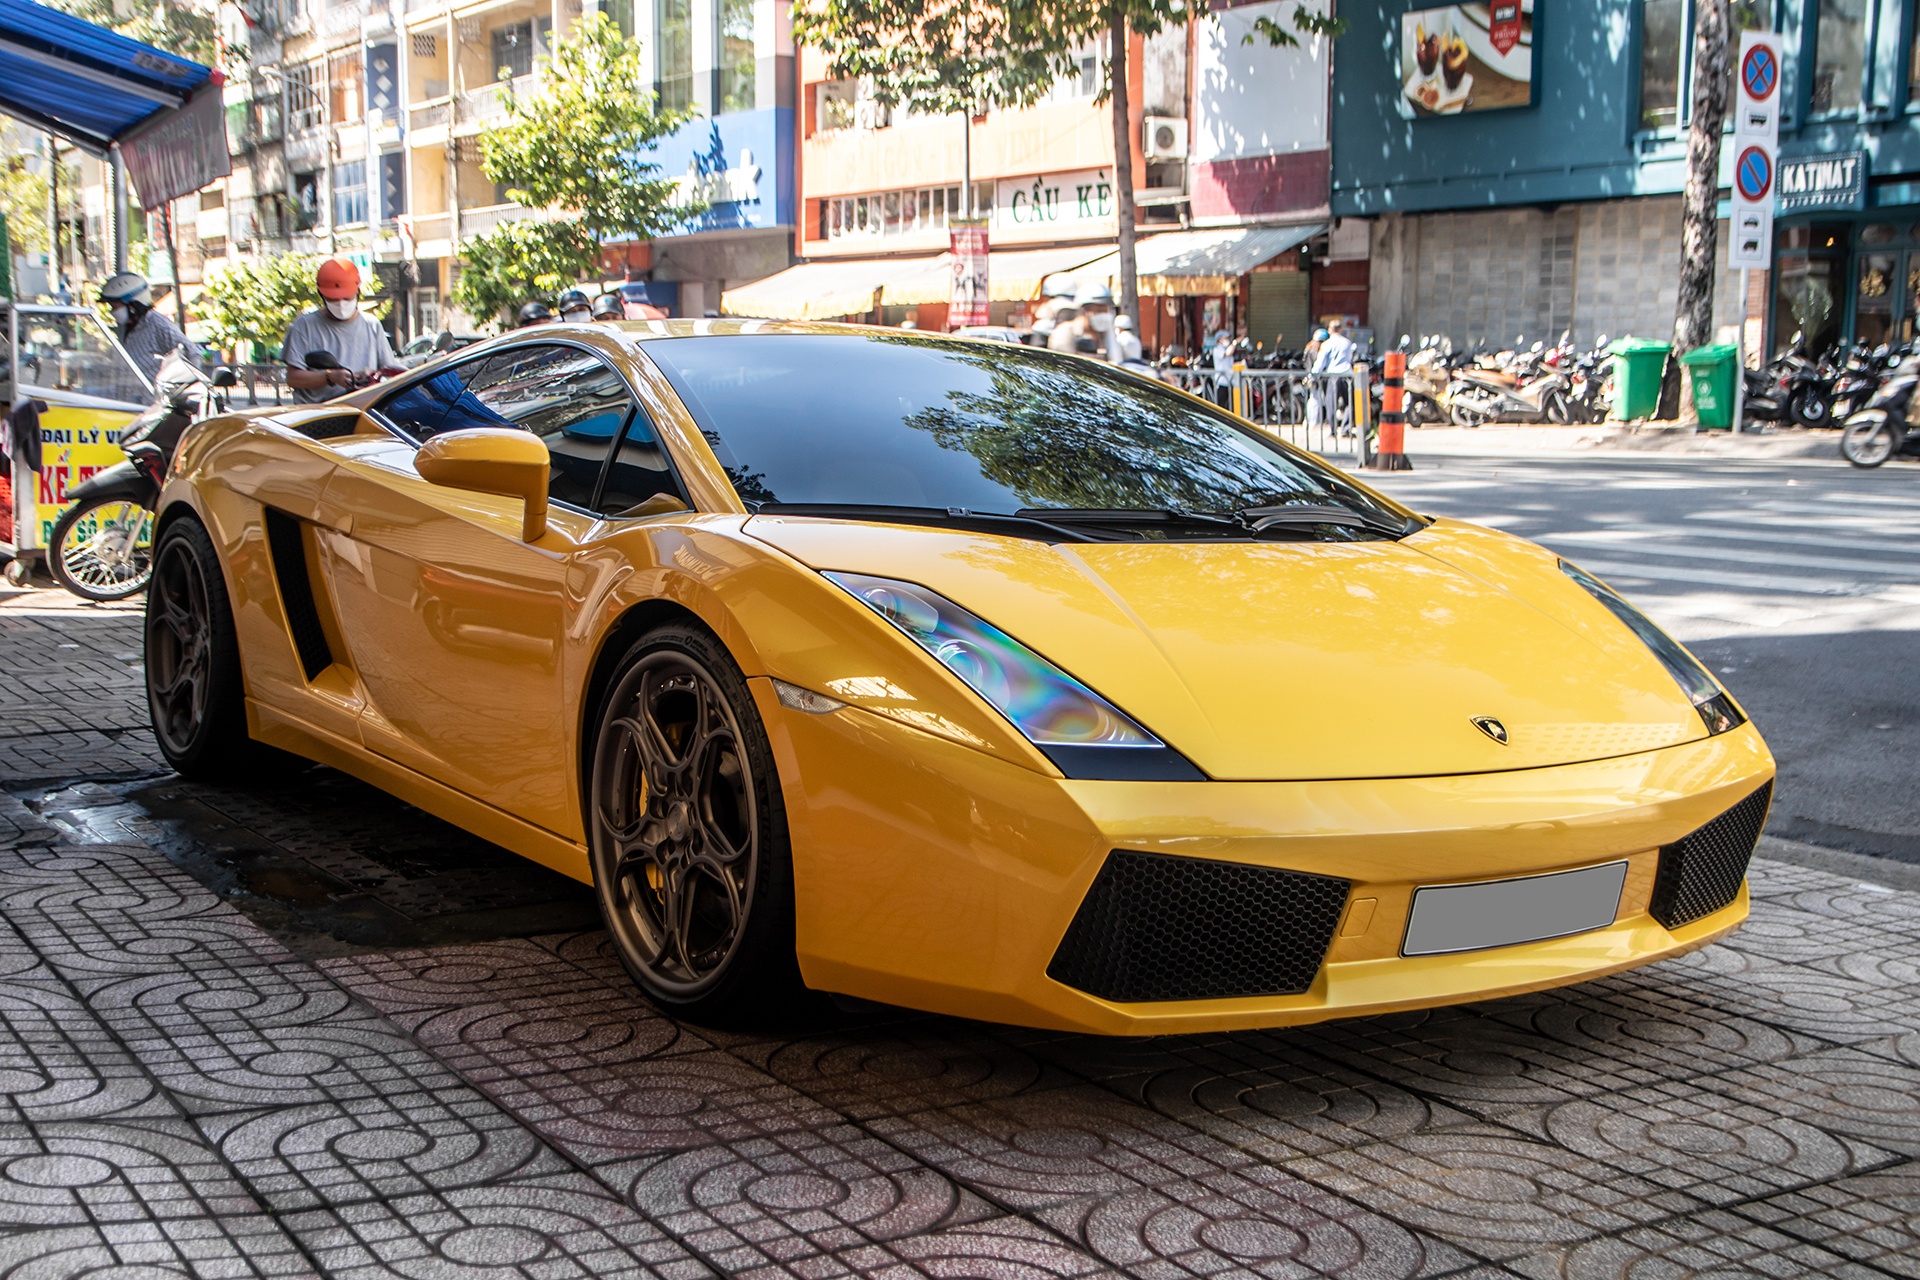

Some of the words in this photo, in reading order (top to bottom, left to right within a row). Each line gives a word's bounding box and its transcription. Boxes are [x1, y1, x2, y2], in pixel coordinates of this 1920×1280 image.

[1012, 174, 1059, 223] CẦU
[1076, 169, 1112, 218] KÈ
[40, 429, 73, 448] ĐẠI
[39, 449, 72, 505] KẾ
